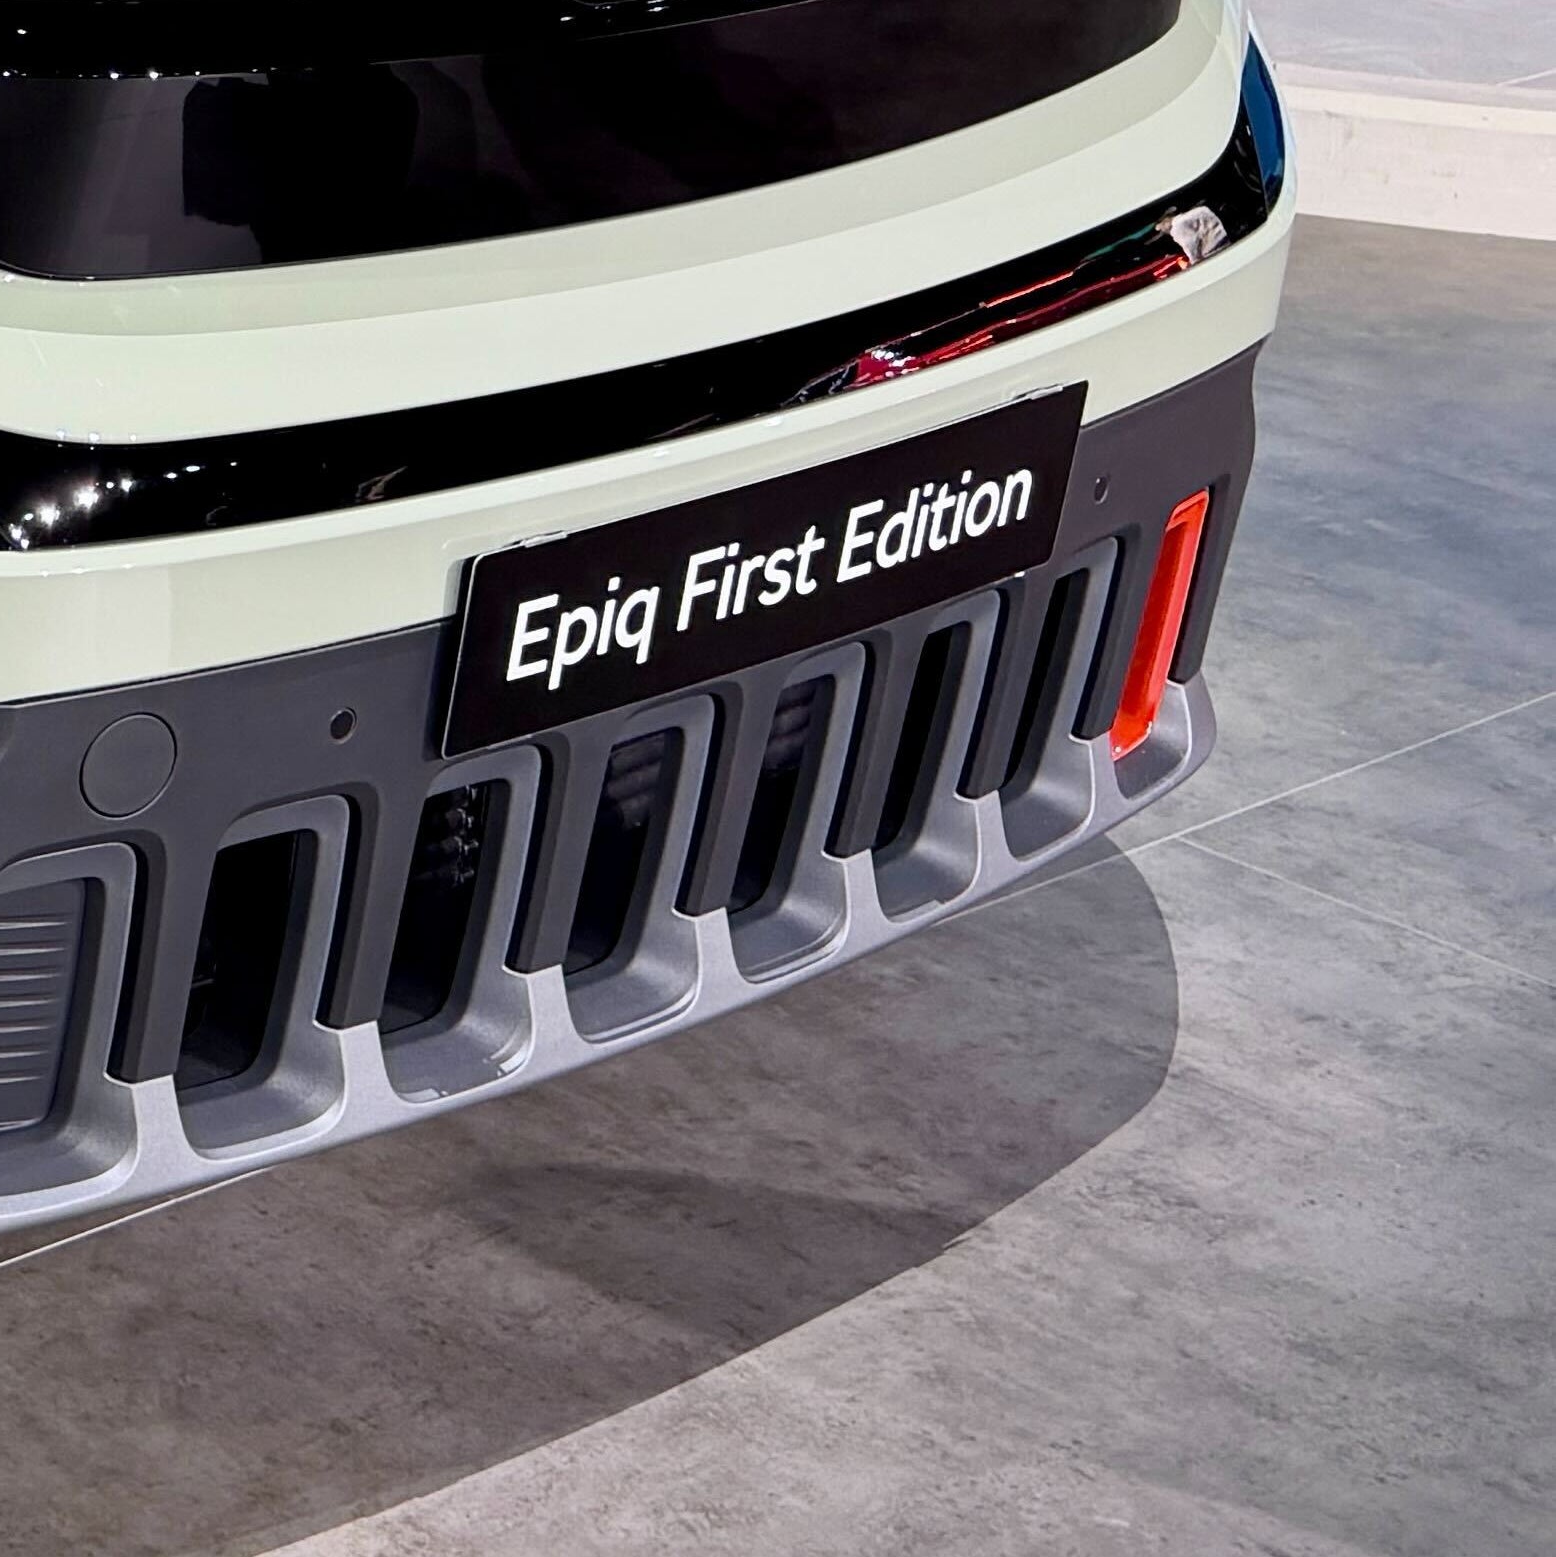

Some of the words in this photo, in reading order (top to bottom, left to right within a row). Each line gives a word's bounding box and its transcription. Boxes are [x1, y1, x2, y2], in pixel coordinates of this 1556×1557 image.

[505, 576, 661, 692] Epiq
[675, 523, 827, 633] First
[835, 467, 1034, 584] Edition
